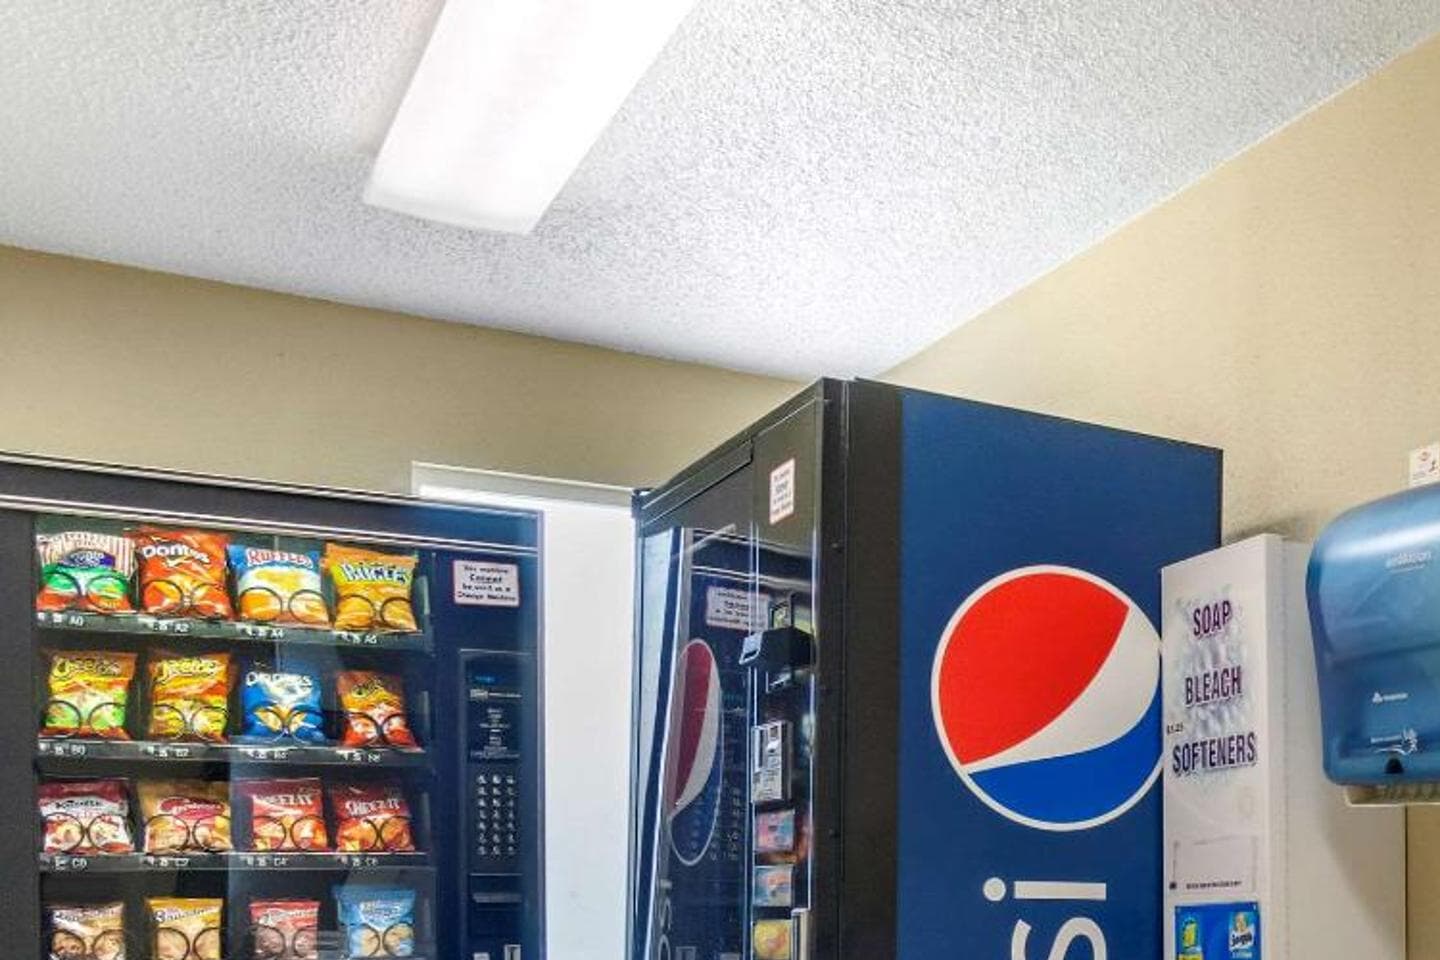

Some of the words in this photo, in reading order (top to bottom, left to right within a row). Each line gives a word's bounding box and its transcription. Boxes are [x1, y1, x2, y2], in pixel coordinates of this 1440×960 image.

[1193, 599, 1232, 637] SOAP
[1185, 665, 1243, 706] BLEACH
[1172, 732, 1257, 774] SOFTENERS
